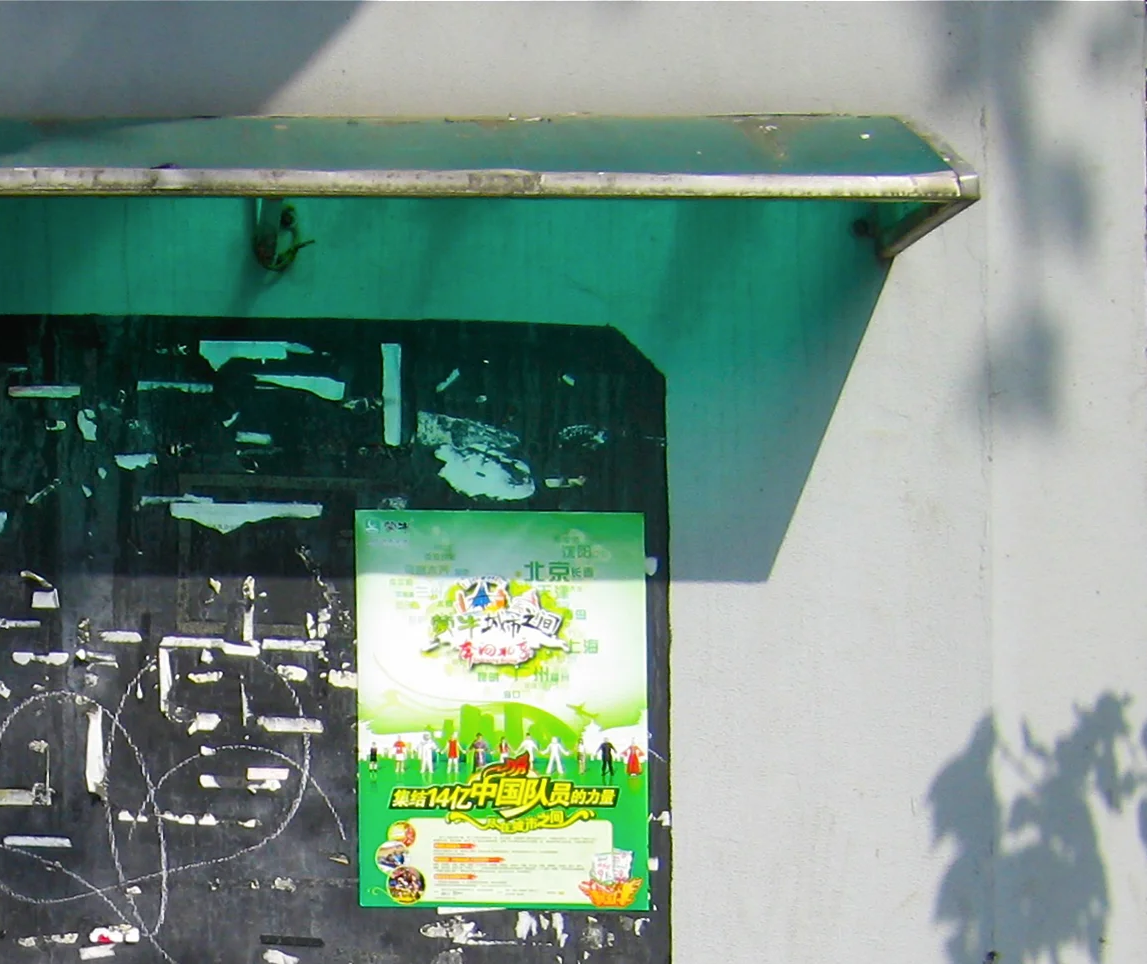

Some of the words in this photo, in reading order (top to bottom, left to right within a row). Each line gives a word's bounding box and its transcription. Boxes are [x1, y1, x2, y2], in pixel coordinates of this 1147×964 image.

[523, 561, 570, 582] 北京
[392, 777, 617, 810] 集结14亿中国队员的力量
